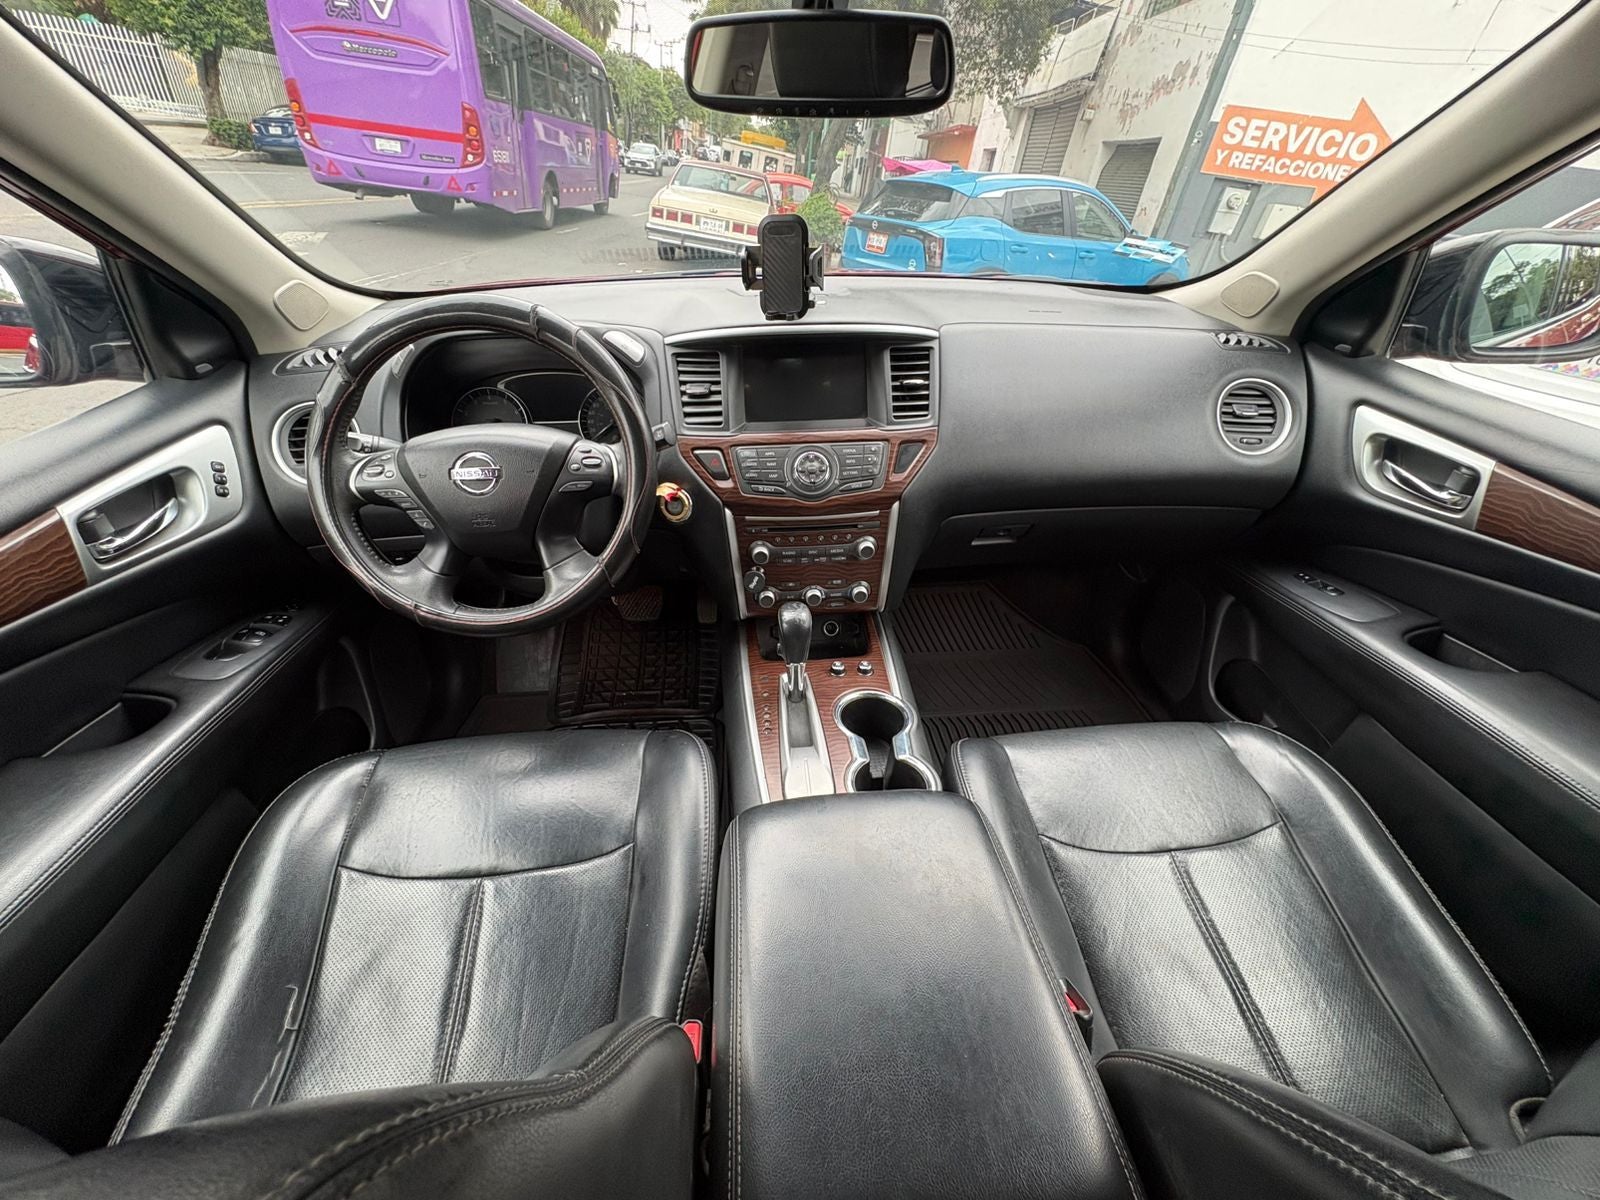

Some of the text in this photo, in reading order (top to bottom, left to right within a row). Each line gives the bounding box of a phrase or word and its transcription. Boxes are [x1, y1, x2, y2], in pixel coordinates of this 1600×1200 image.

[1222, 116, 1378, 162] SERVICIO
[1215, 149, 1361, 181] Y REFACCIONE
[455, 469, 498, 478] NISSAN
